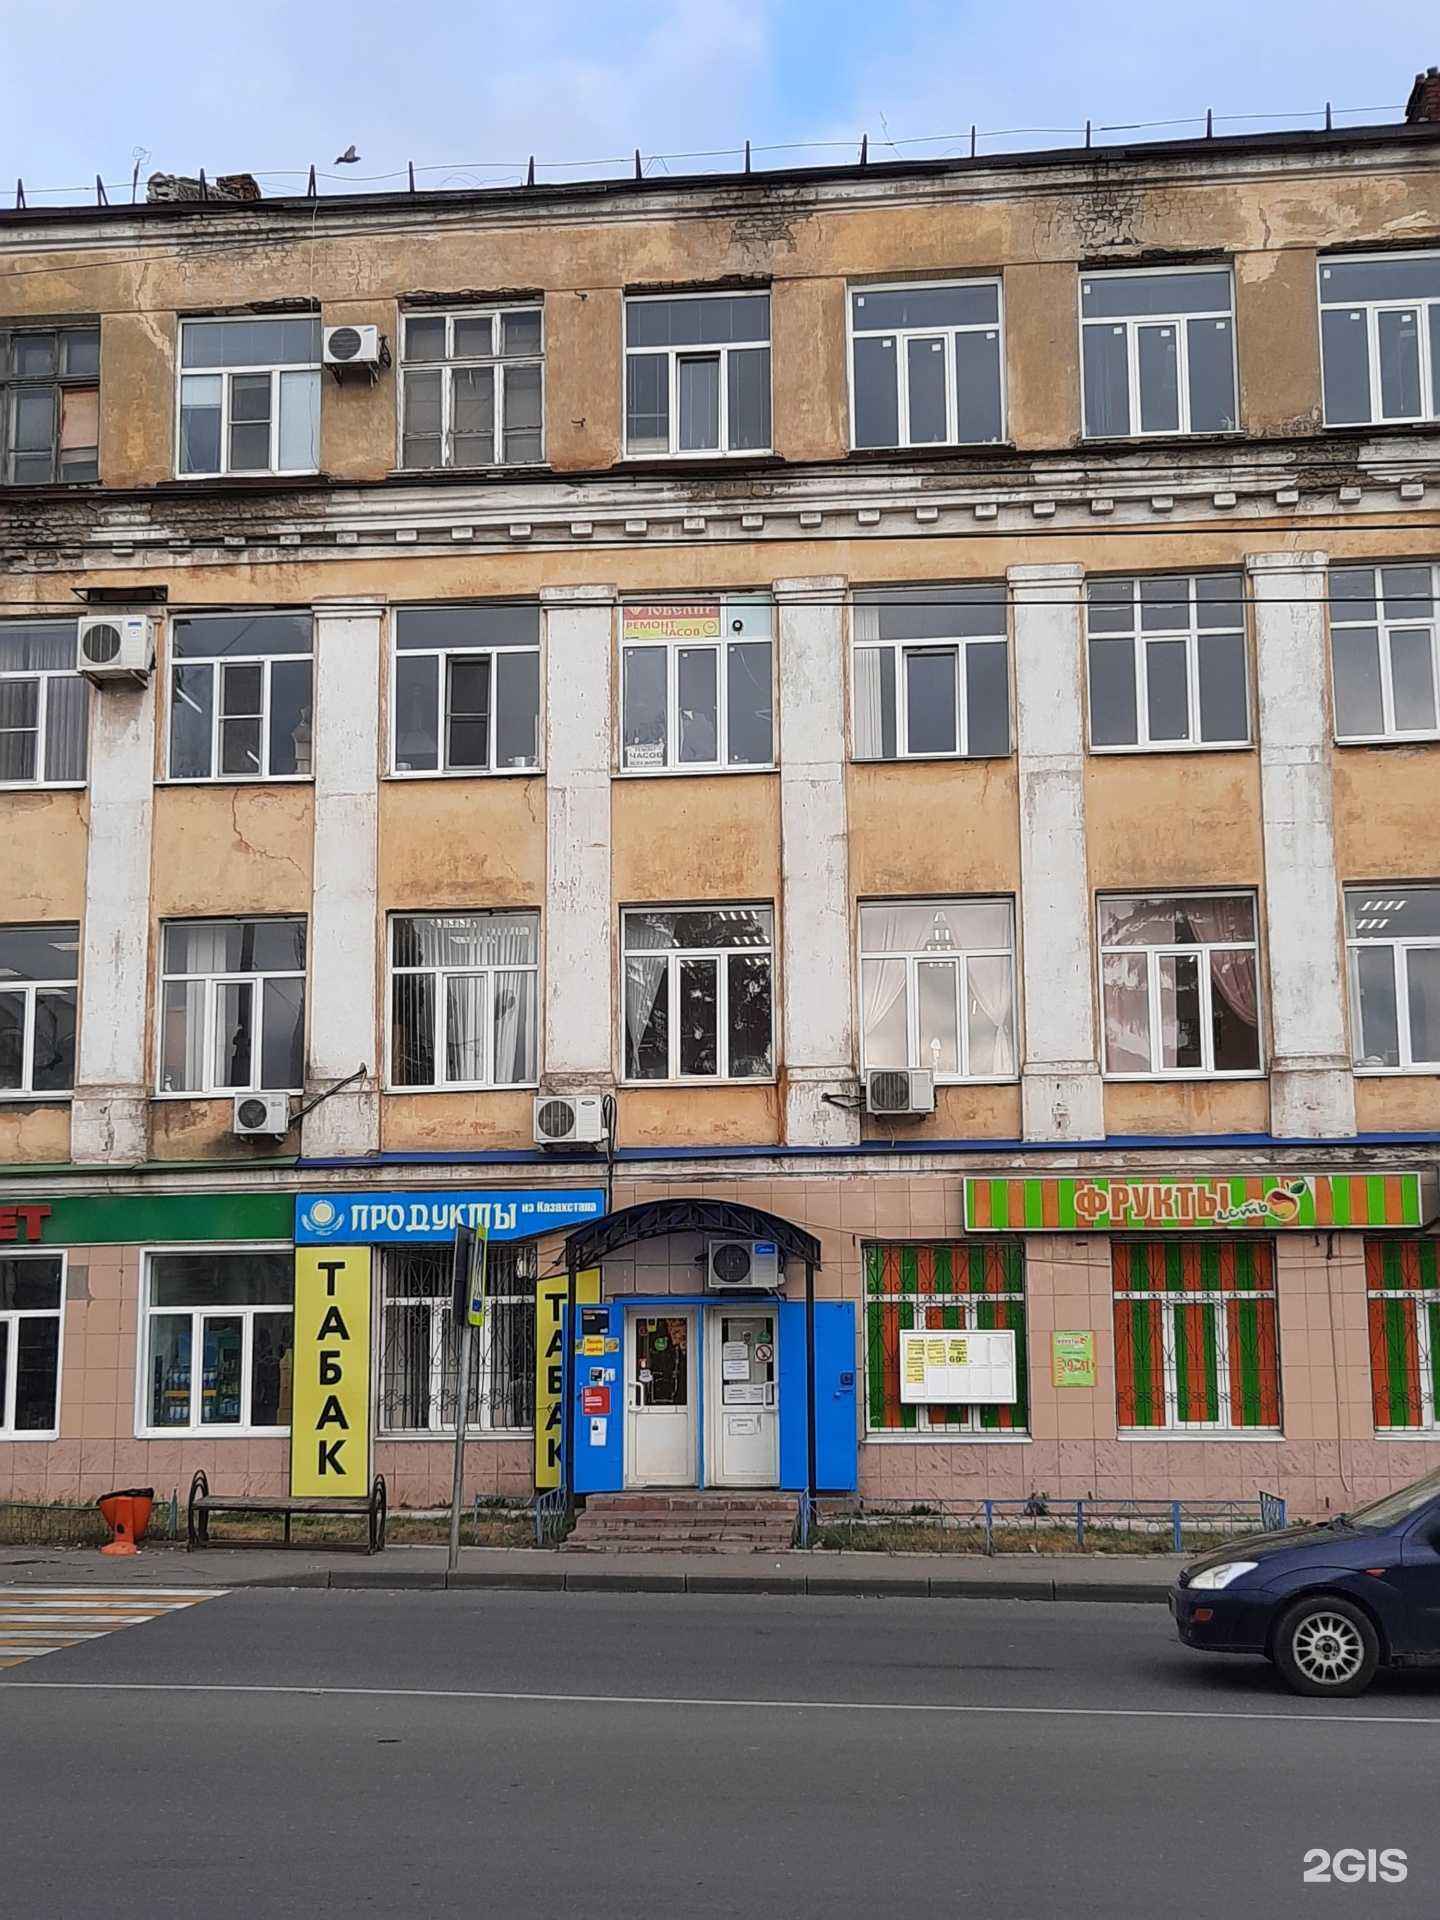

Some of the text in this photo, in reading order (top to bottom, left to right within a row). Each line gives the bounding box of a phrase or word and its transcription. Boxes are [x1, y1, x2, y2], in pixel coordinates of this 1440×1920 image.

[351, 1202, 517, 1232] ПРОДУКТЫ
[537, 1201, 597, 1213] Казахстана
[1075, 1184, 1230, 1219] ФРУКТЫ
[316, 1262, 350, 1475] ТАБАК
